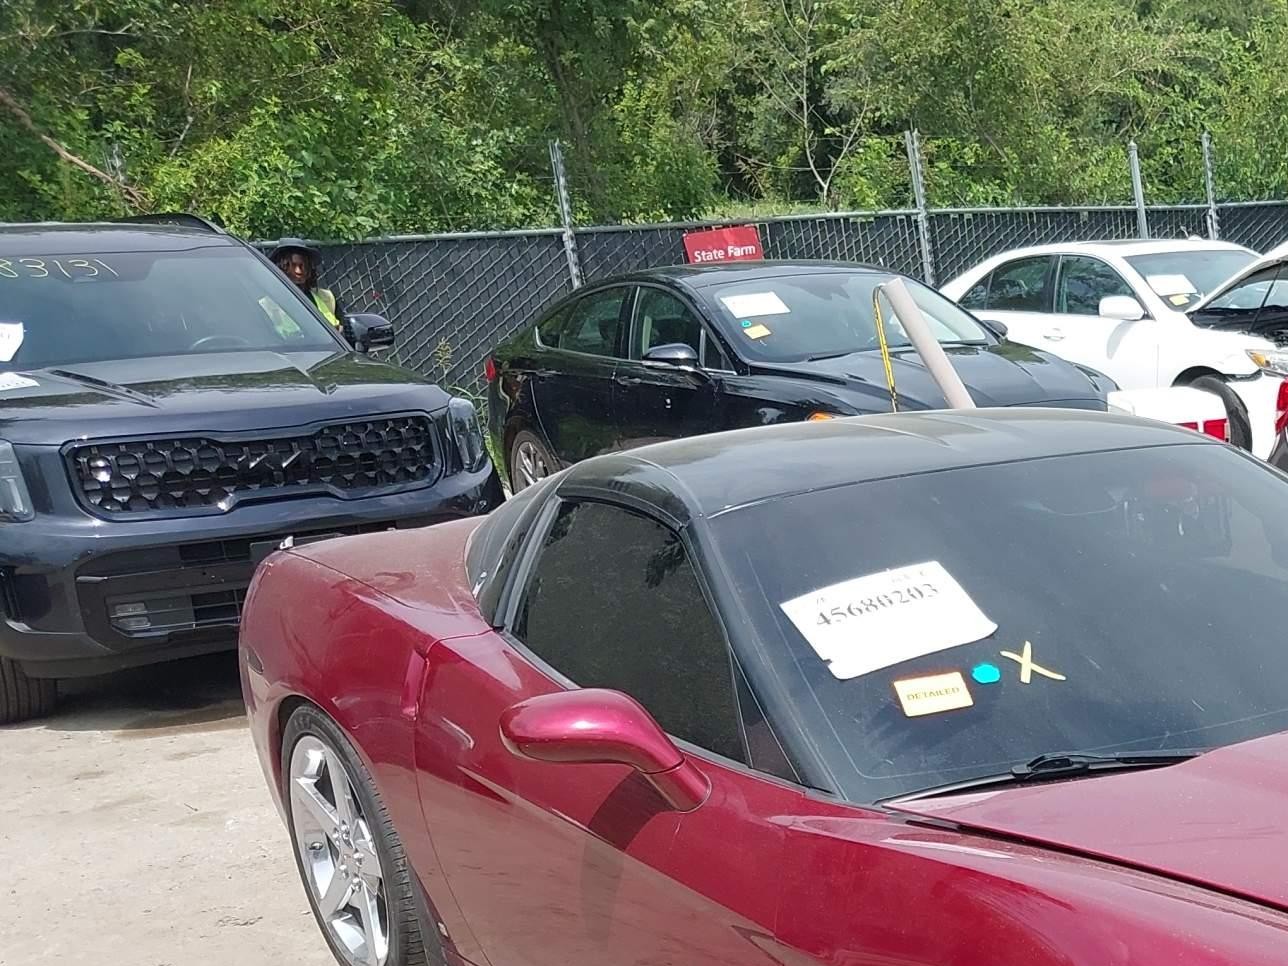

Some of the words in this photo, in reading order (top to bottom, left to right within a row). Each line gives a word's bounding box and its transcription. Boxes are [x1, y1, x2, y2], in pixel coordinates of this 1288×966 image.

[693, 248, 725, 263] State
[727, 245, 756, 257] Farm
[816, 583, 939, 627] 45680203
[906, 686, 961, 701] DETAILED
